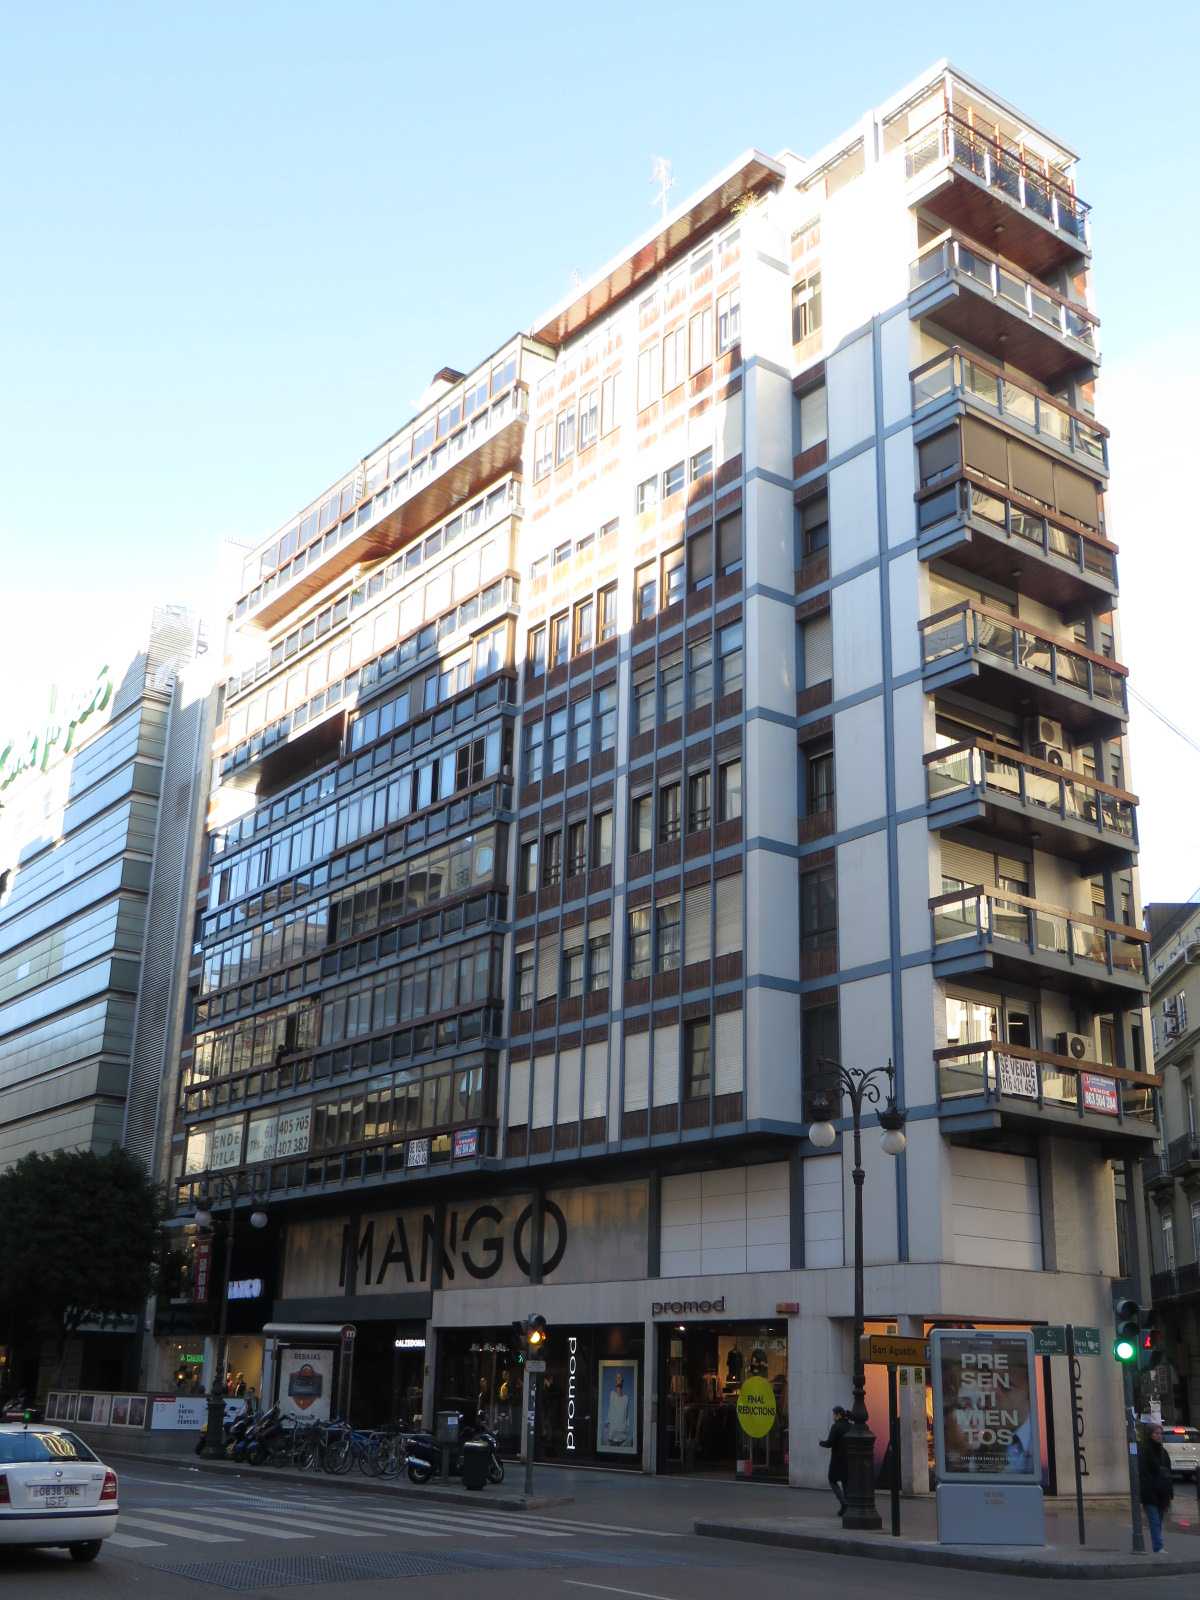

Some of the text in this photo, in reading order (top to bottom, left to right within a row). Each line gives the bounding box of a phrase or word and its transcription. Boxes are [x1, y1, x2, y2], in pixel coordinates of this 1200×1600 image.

[1000, 1059, 1035, 1080] SE VENDE
[1089, 1087, 1110, 1096] VENDE
[294, 1116, 309, 1133] 705
[339, 1200, 567, 1287] MANGO
[651, 1296, 725, 1317] promod
[961, 1353, 1009, 1370] PRE
[961, 1372, 1010, 1389] SEN
[566, 1337, 577, 1450] promod
[747, 1395, 765, 1404] FINAL
[976, 1391, 996, 1408] TI
[738, 1406, 777, 1417] REDUCTIONS
[956, 1409, 1019, 1426] MIEN
[1073, 1358, 1090, 1476] promo
[963, 1428, 1013, 1445] TOS
